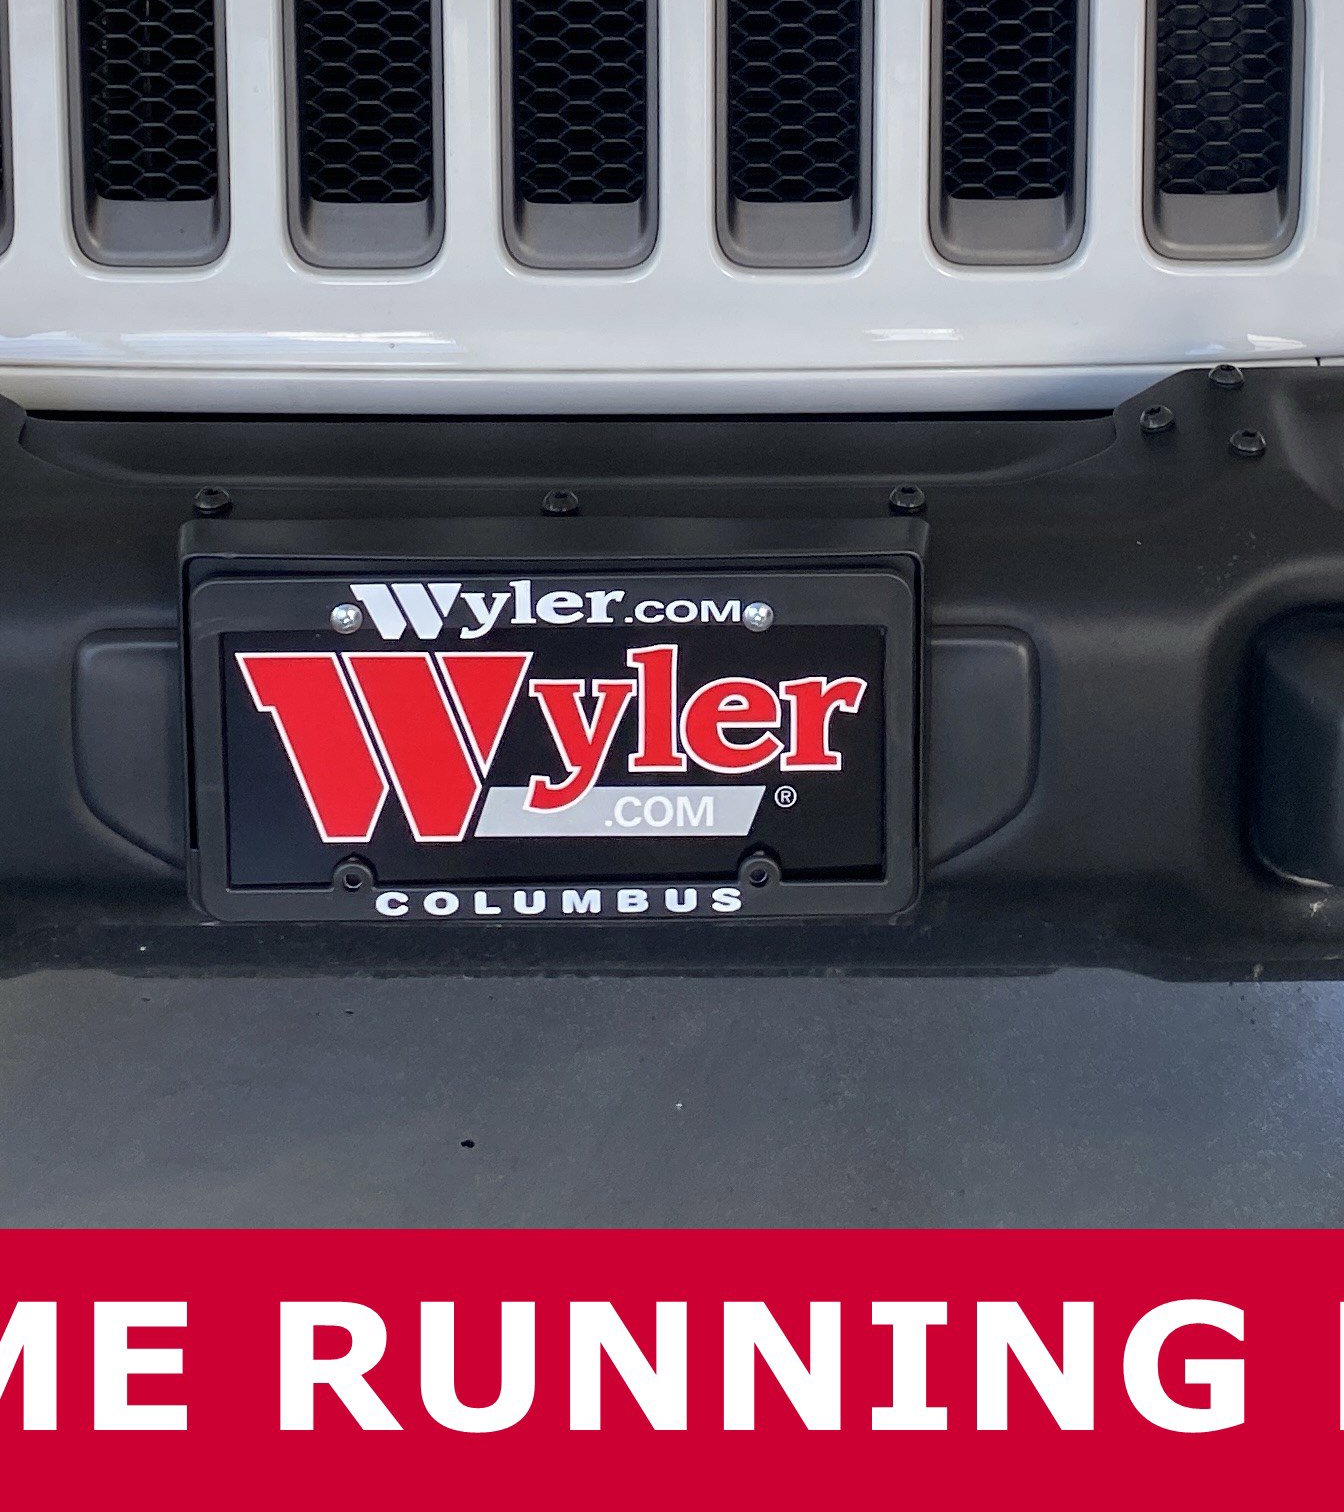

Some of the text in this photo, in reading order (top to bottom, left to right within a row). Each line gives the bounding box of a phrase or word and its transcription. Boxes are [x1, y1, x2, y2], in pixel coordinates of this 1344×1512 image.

[234, 643, 868, 843] Wyler
[604, 795, 715, 828] .COM
[375, 887, 742, 917] COLUMBUS
